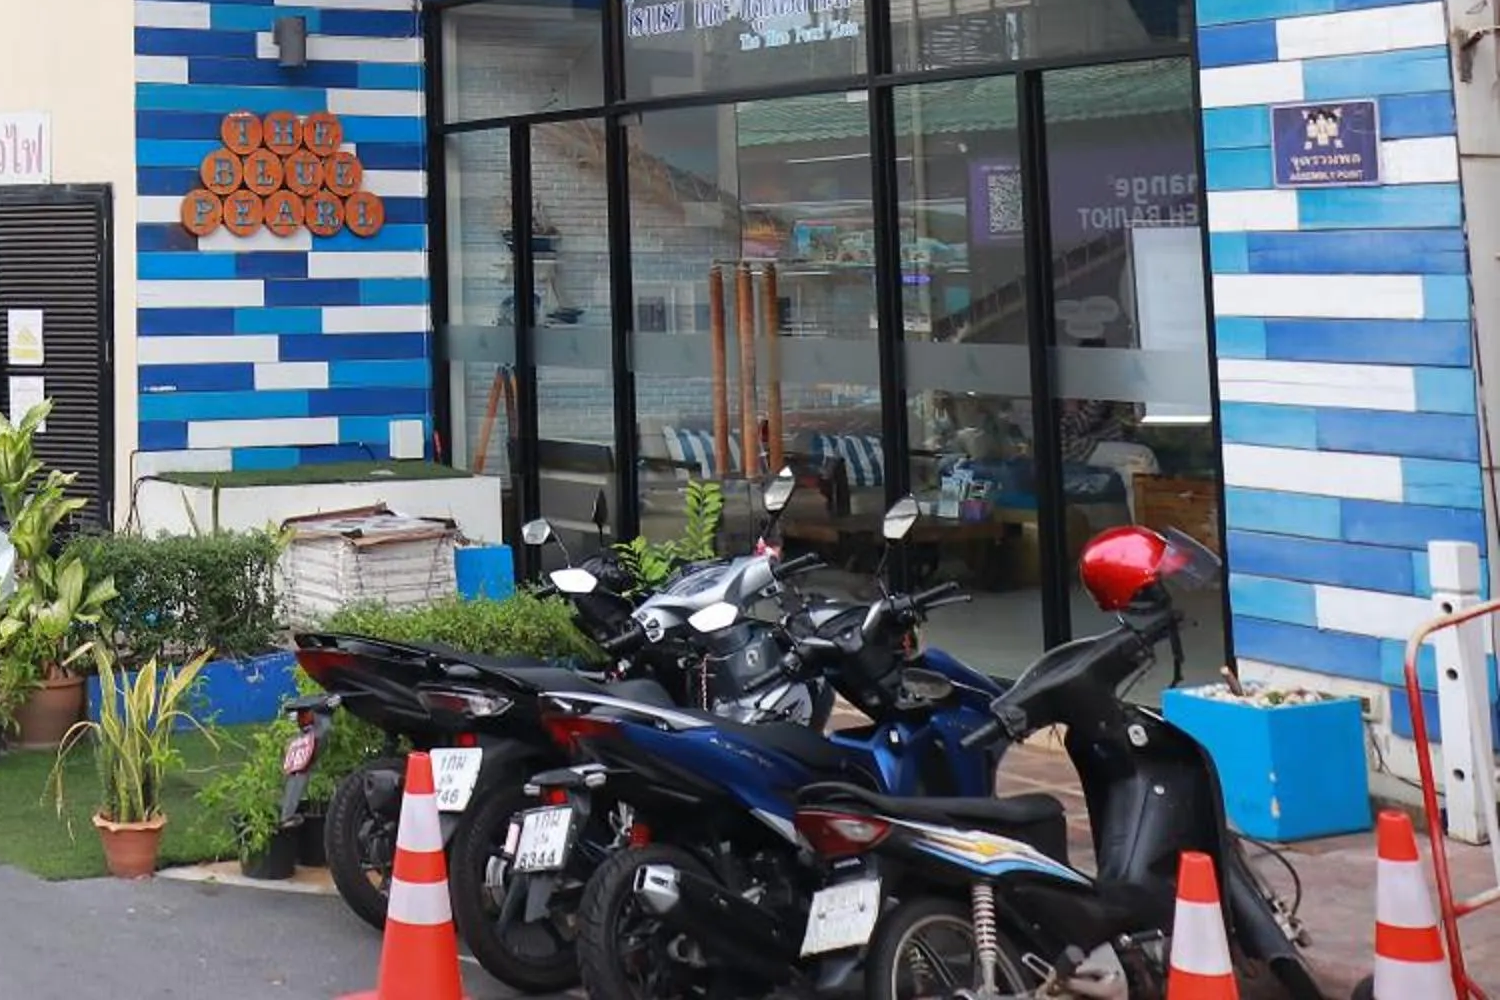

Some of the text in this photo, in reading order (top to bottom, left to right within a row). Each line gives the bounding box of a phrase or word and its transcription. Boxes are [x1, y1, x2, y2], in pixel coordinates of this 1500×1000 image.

[232, 118, 333, 147] THE
[214, 158, 353, 187] BLUE
[193, 197, 375, 227] PEARL
